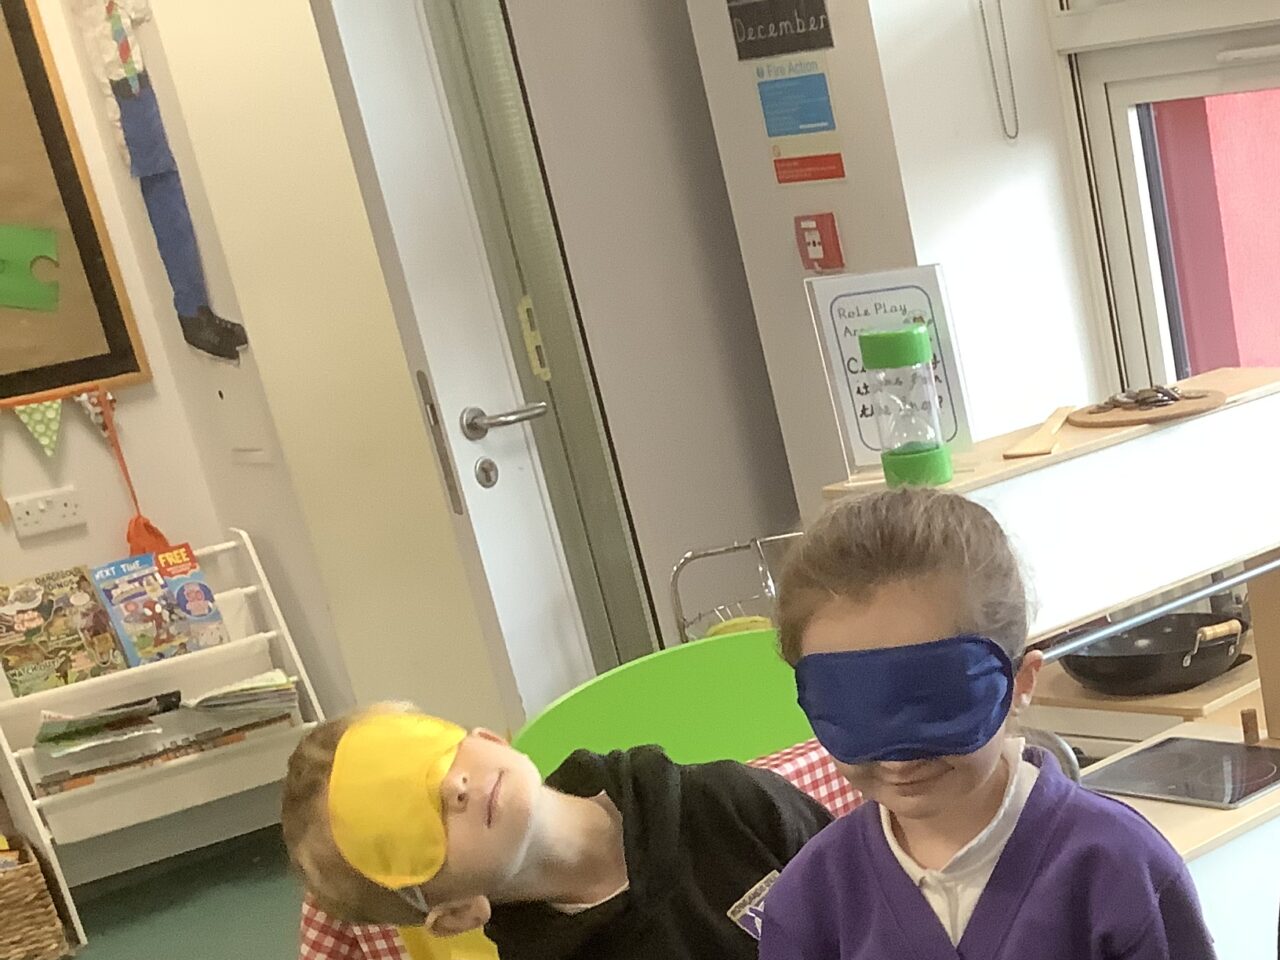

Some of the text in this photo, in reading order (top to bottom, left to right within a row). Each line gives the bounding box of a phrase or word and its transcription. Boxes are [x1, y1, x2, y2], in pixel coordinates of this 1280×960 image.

[733, 9, 827, 43] December
[838, 301, 908, 320] Role Play
[157, 548, 190, 568] FREE
